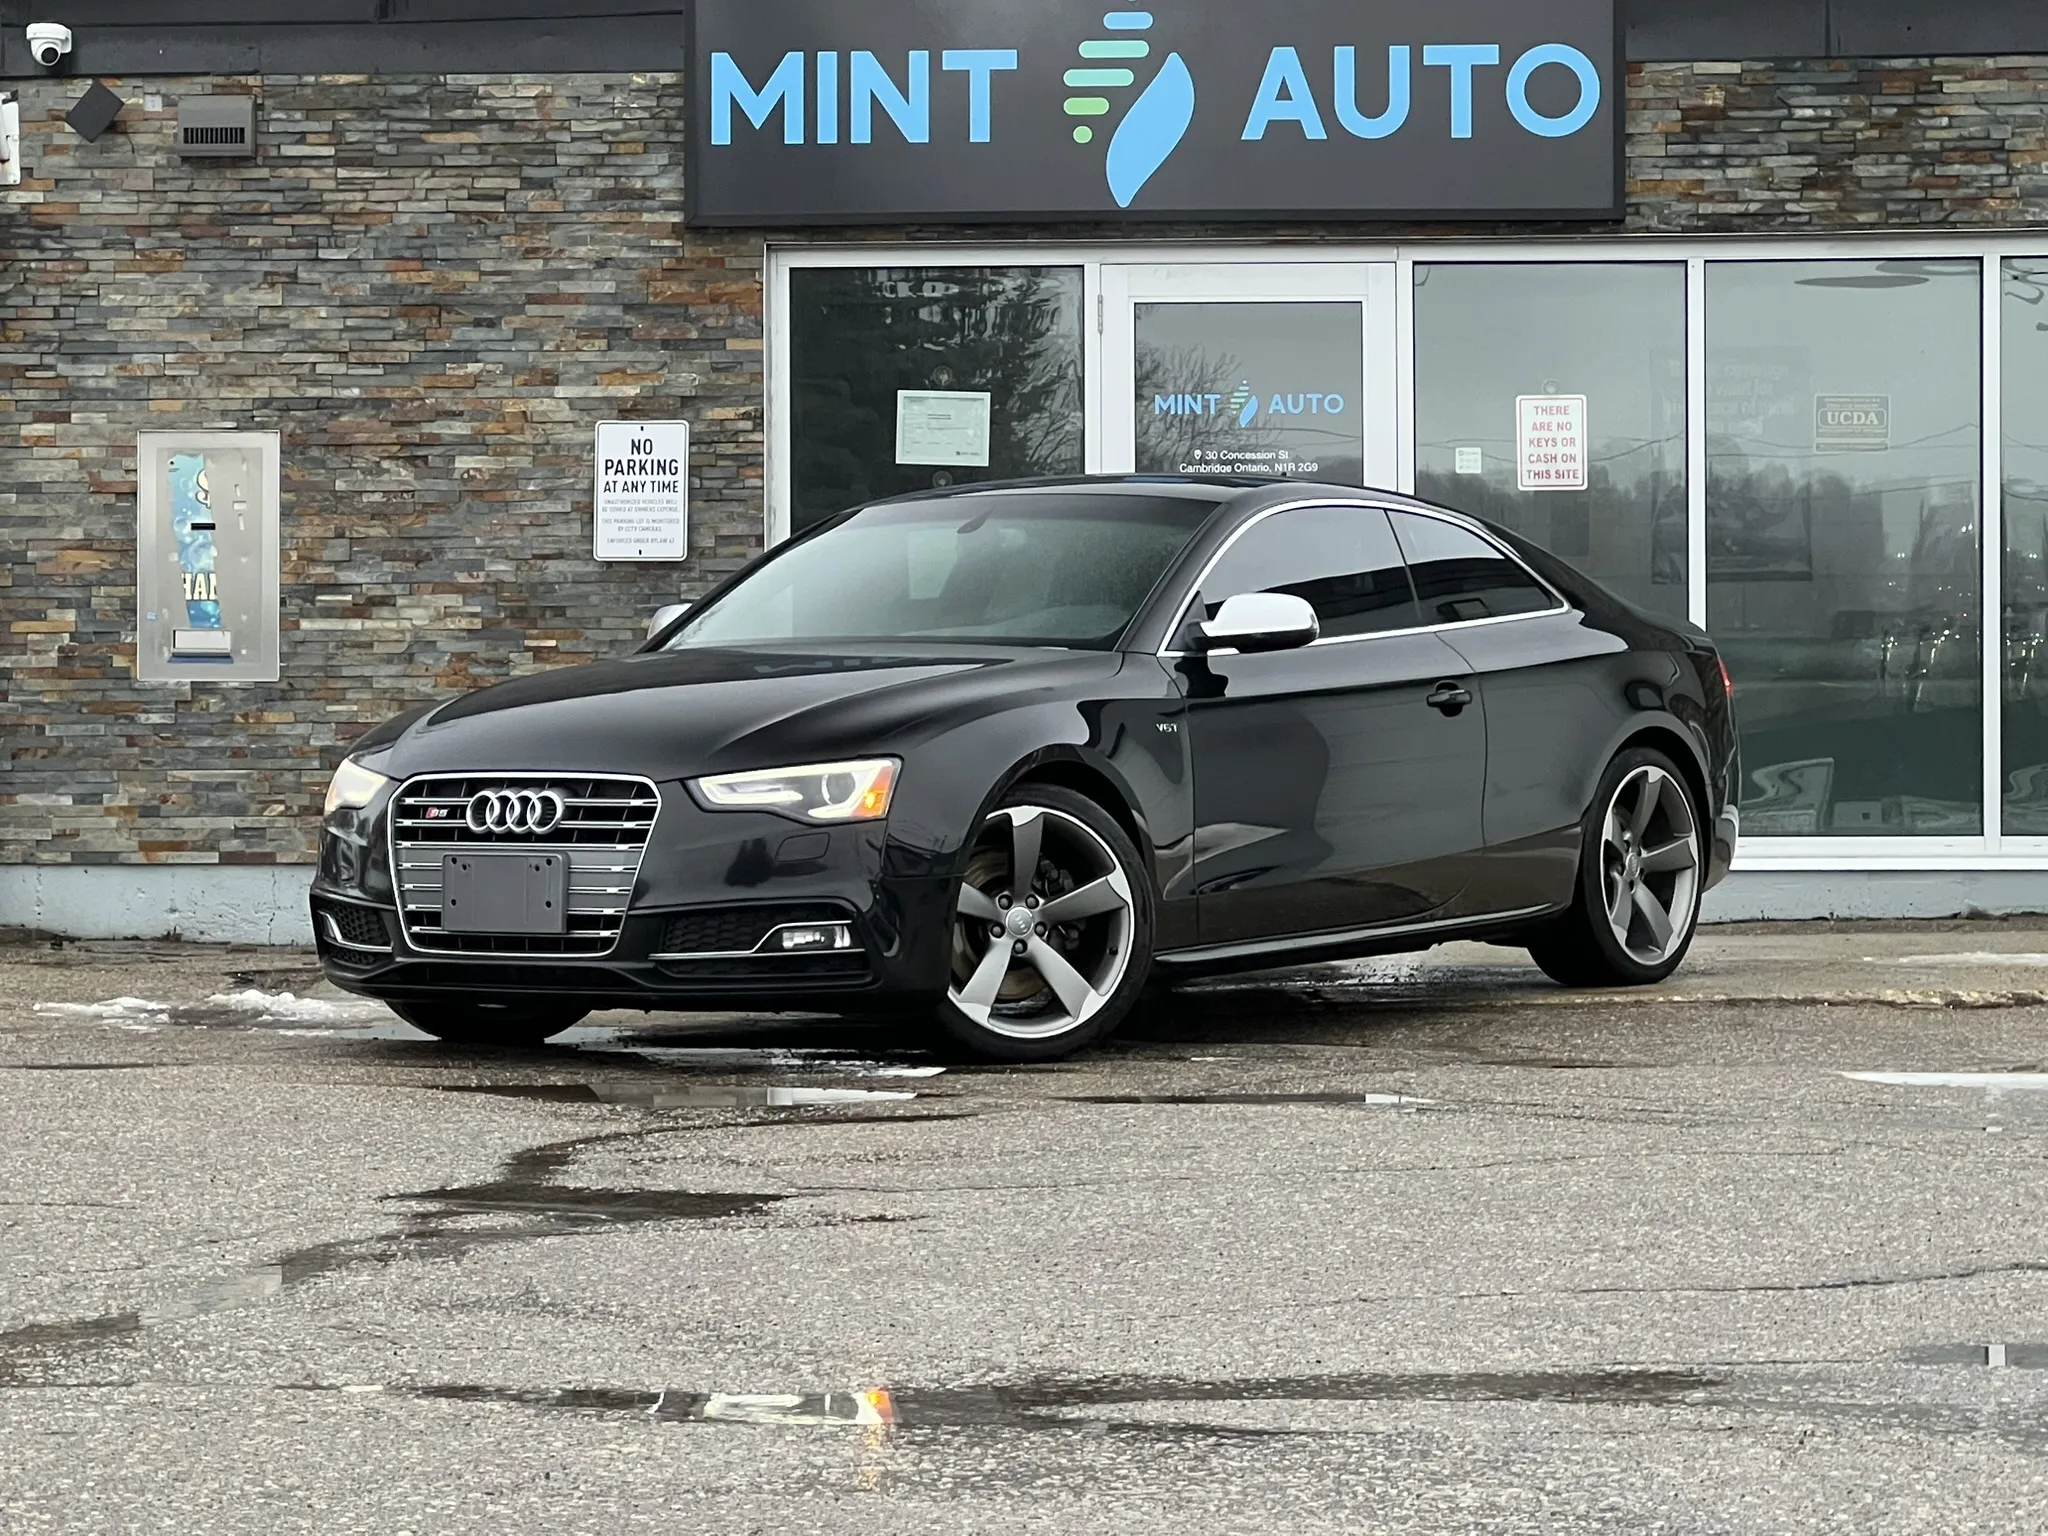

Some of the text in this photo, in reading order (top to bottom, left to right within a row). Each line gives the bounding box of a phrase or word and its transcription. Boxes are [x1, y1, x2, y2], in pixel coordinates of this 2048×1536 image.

[711, 43, 1601, 145] MINT AUTO
[1154, 393, 1345, 415] MINT AUTO
[1533, 405, 1570, 416] THERE
[1826, 411, 1880, 425] UCDA
[1531, 421, 1573, 432] ARE NO
[630, 438, 653, 456] NO
[1528, 437, 1577, 448] KEYS OR
[1205, 450, 1218, 460] 30
[1220, 450, 1276, 460] Concession
[1527, 453, 1577, 464] CASH ON
[604, 458, 679, 476] PARKING
[1274, 462, 1296, 472] N1R
[1297, 462, 1319, 472] 2G9
[1526, 468, 1580, 480] THIS SITE
[603, 480, 679, 493] AT ANY TIME
